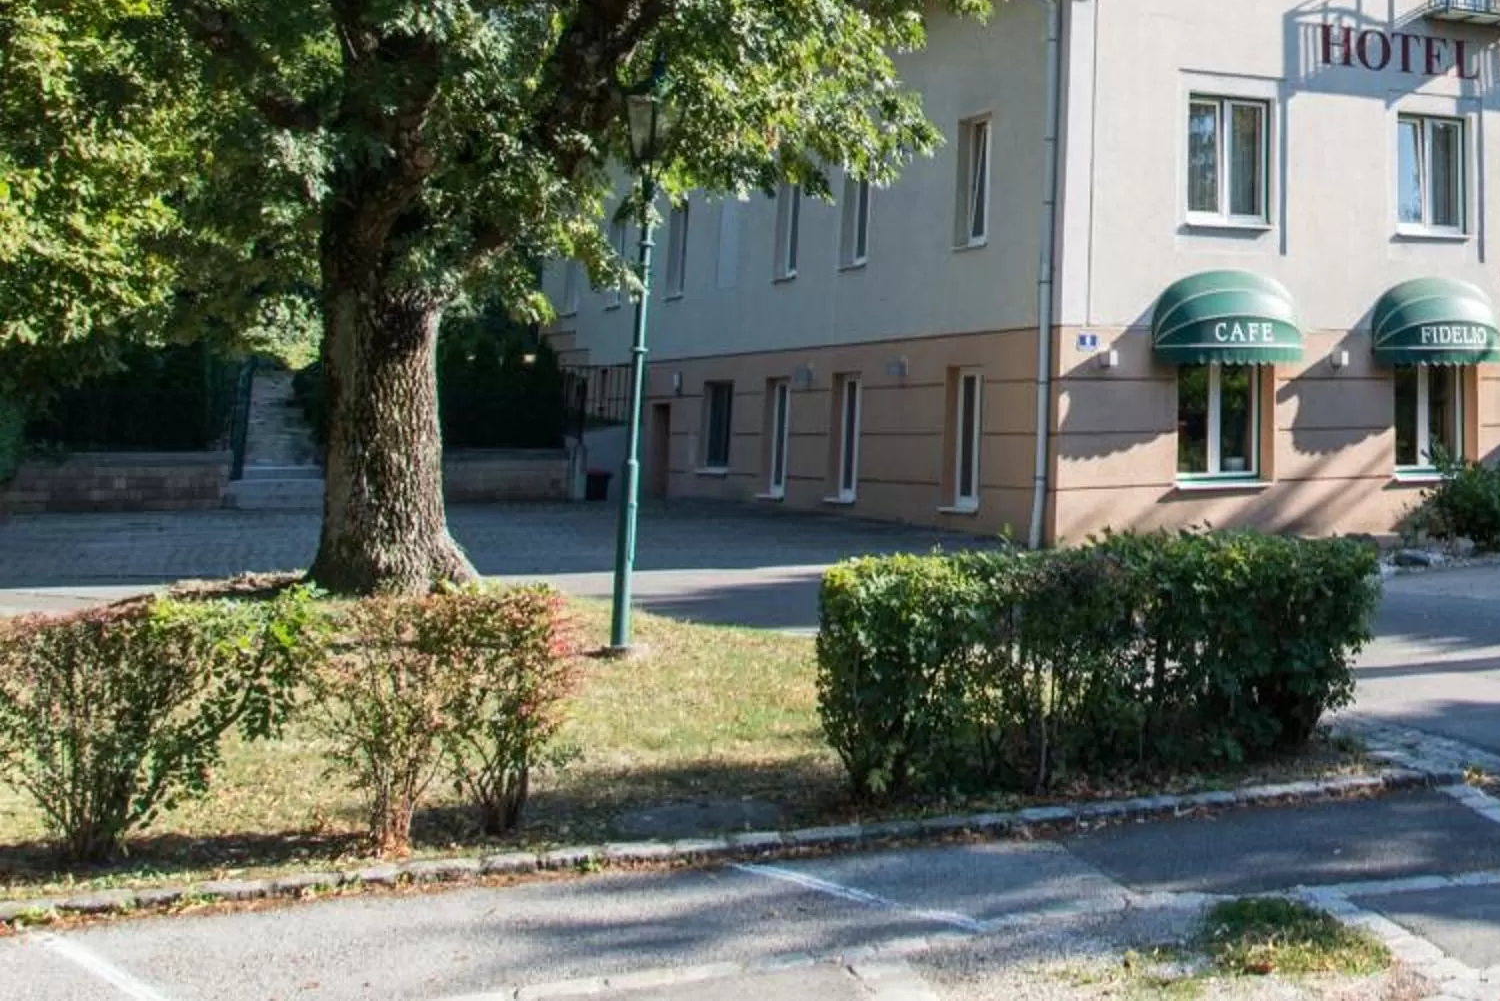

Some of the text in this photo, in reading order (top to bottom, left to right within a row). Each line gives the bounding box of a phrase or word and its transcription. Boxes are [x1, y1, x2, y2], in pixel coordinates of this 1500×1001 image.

[1321, 23, 1481, 80] HOTEL
[1215, 321, 1274, 342] CAFE
[1421, 325, 1488, 344] FIDELIO
